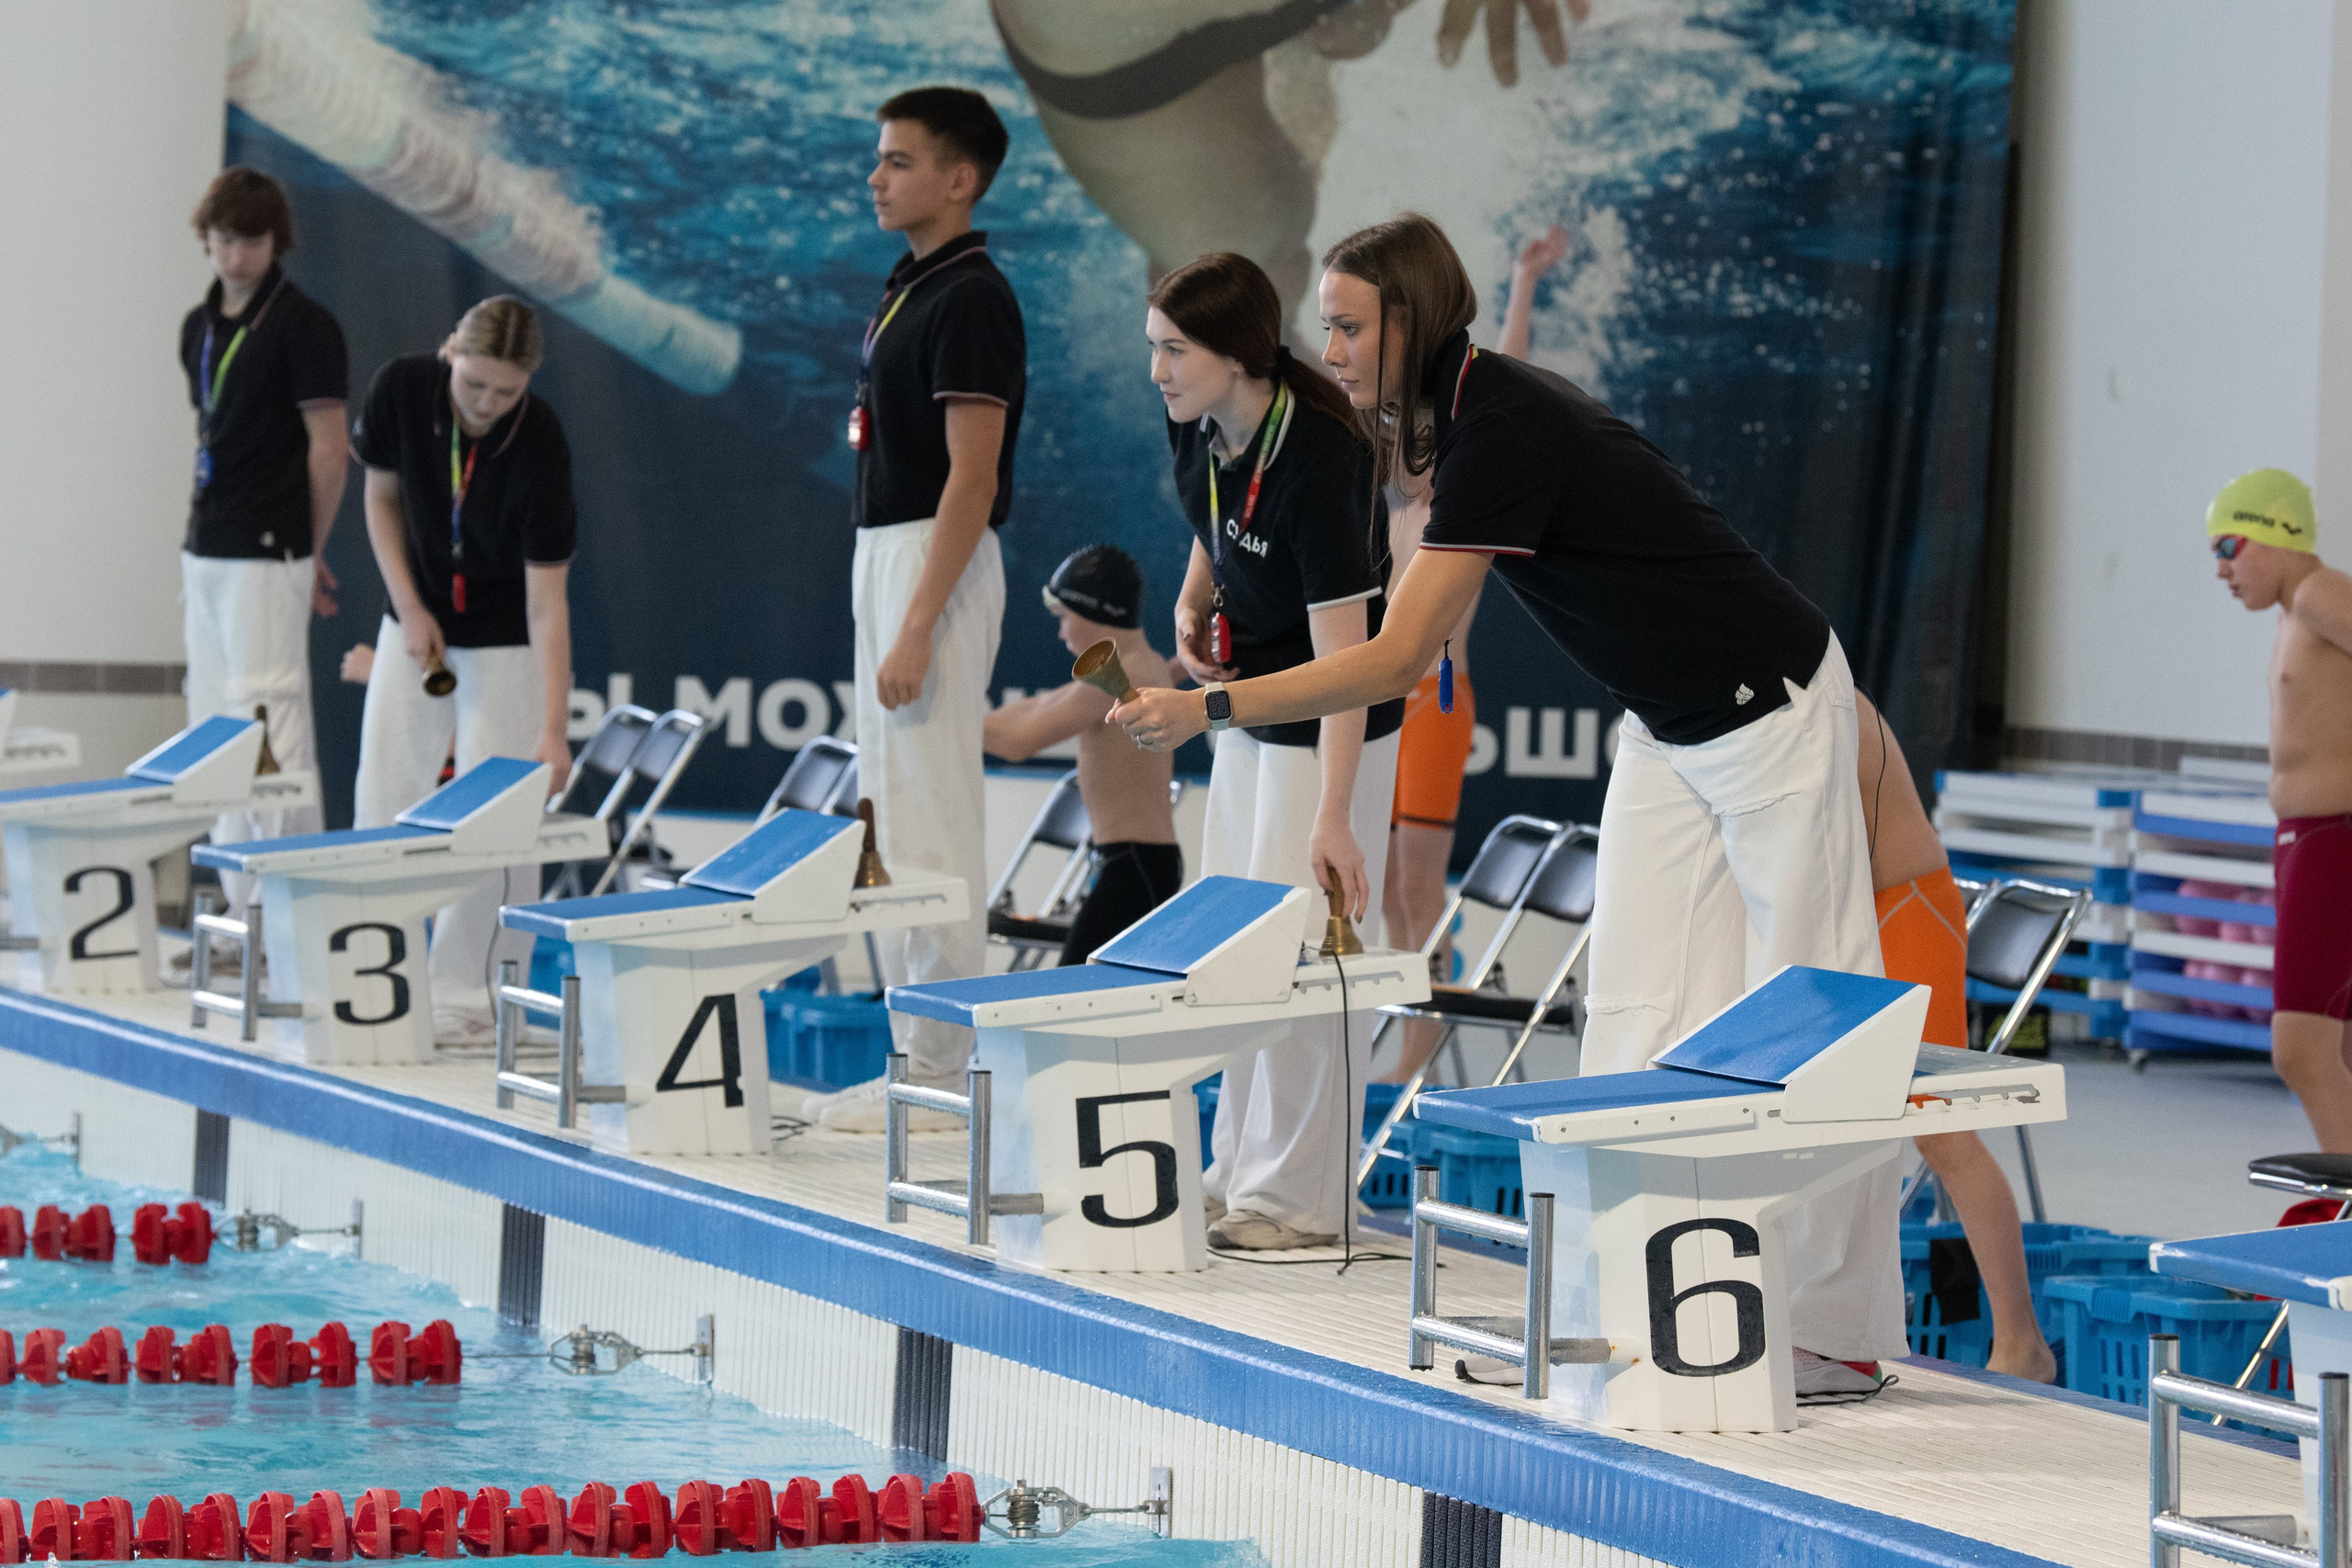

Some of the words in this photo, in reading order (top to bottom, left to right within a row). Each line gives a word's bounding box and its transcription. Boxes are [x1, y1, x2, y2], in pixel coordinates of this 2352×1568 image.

[64, 866, 139, 961] 2
[329, 922, 410, 1026] 3
[656, 993, 744, 1108] 4
[1075, 1089, 1180, 1228] 5
[1645, 1217, 1766, 1378] 6
